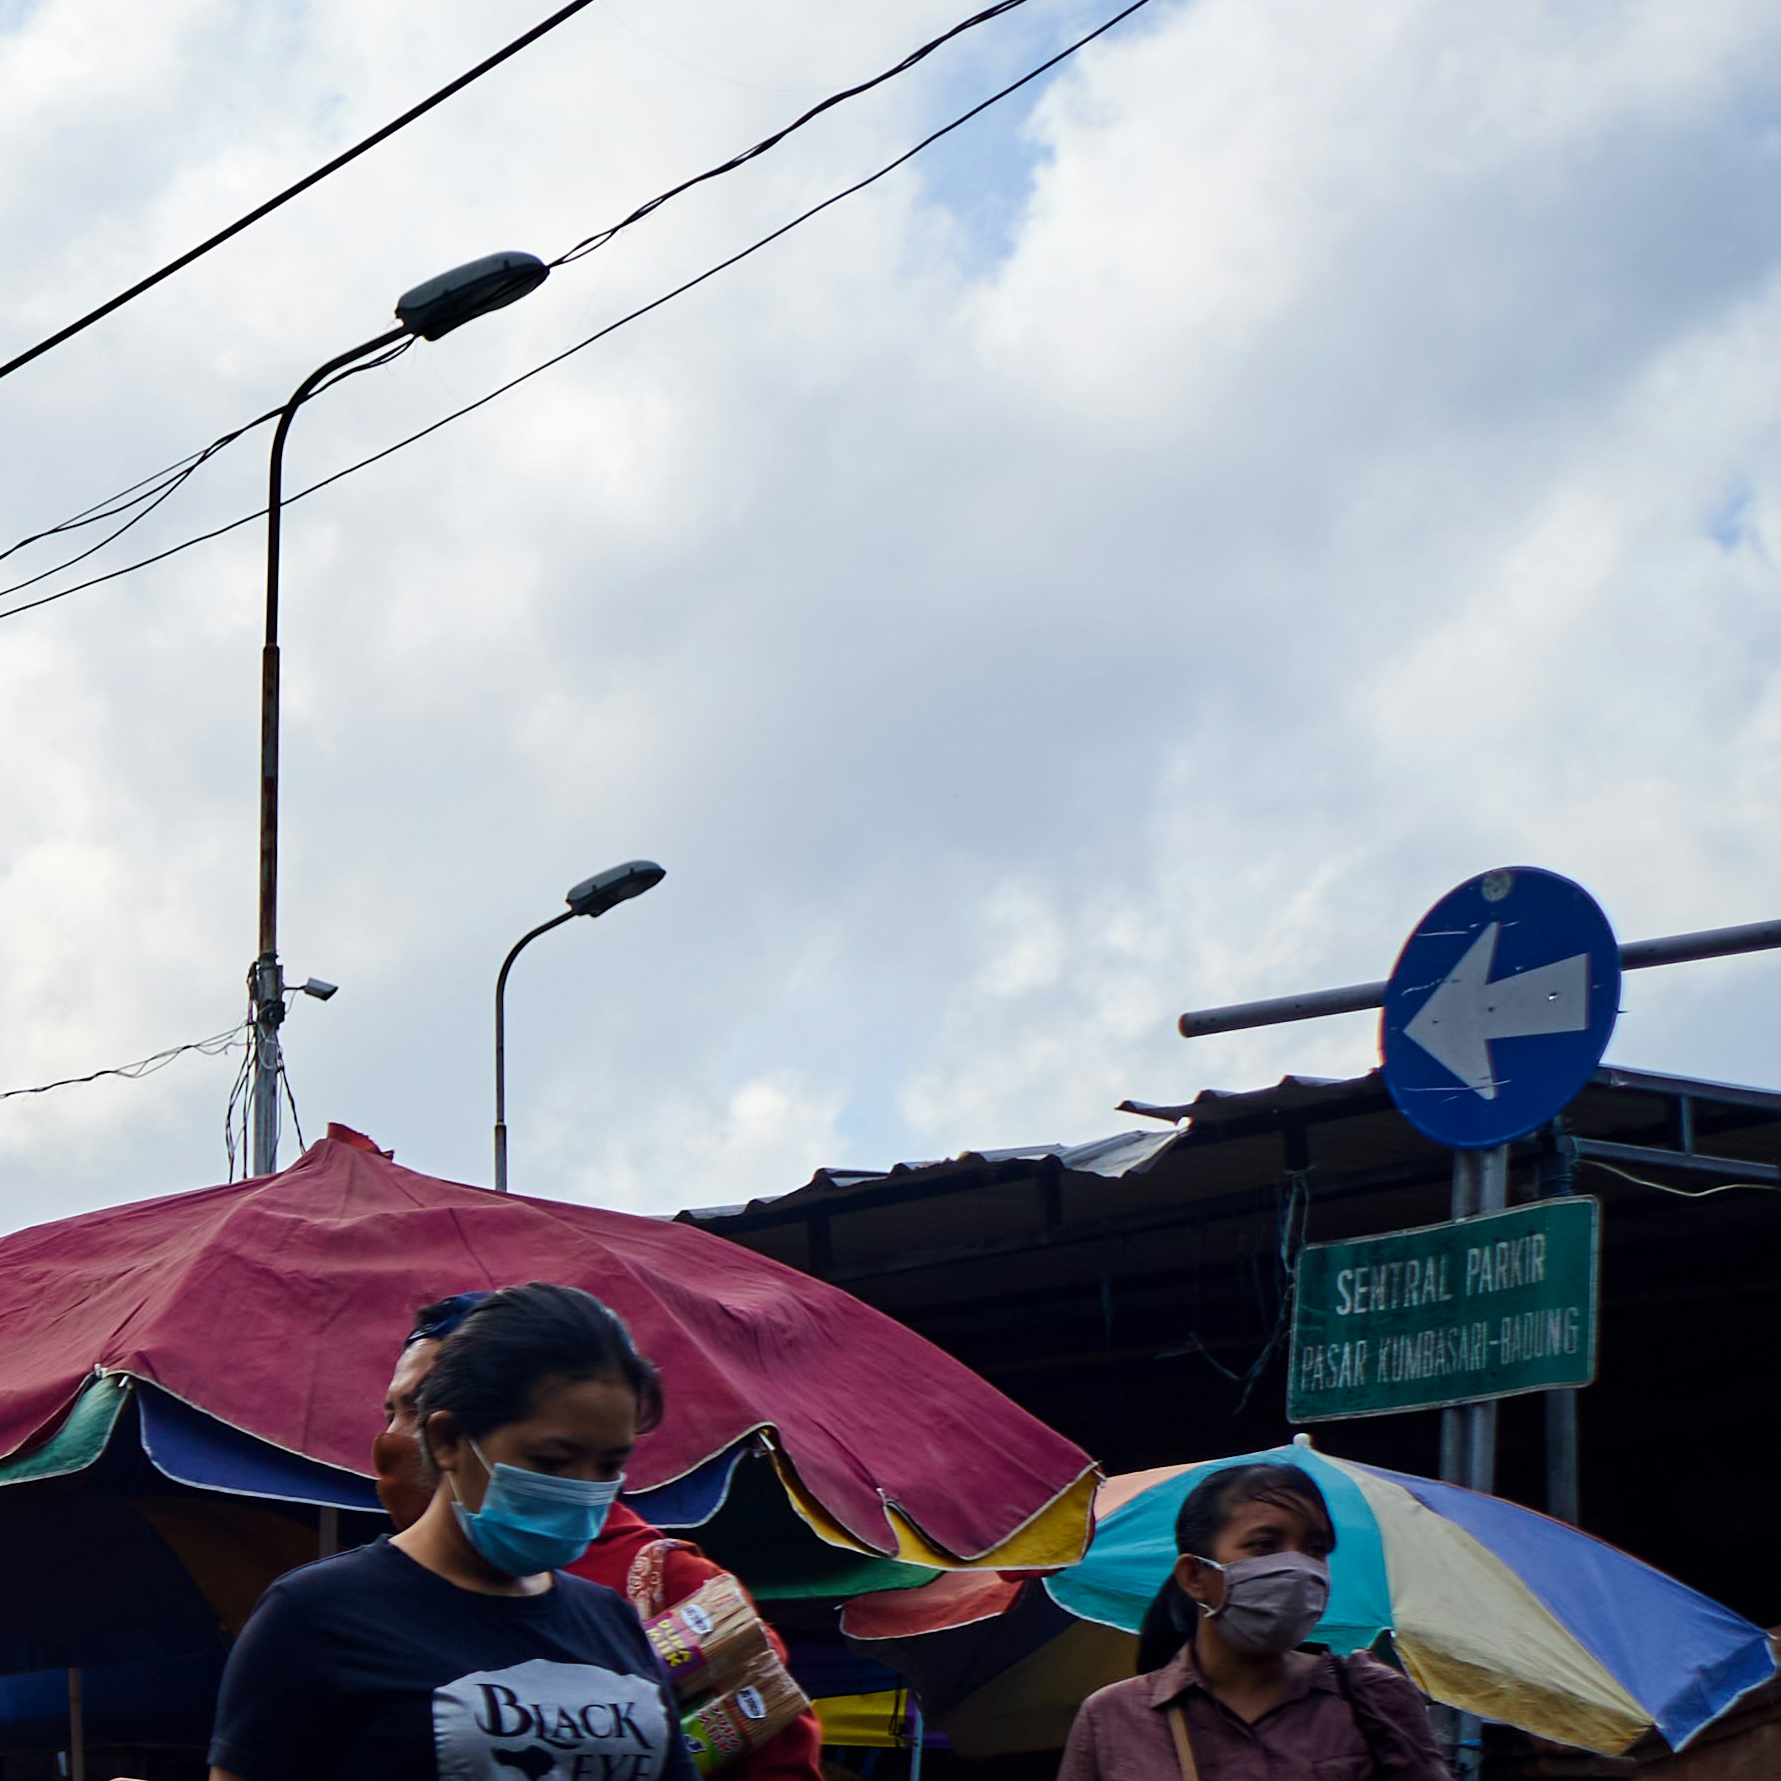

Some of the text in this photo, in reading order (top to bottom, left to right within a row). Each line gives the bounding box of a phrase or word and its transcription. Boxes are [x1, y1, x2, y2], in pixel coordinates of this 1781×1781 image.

[1335, 1233, 1546, 1316] SENTRAL PARKIR
[1301, 1306, 1579, 1392] PASAR KUMBASARI-BADUNG
